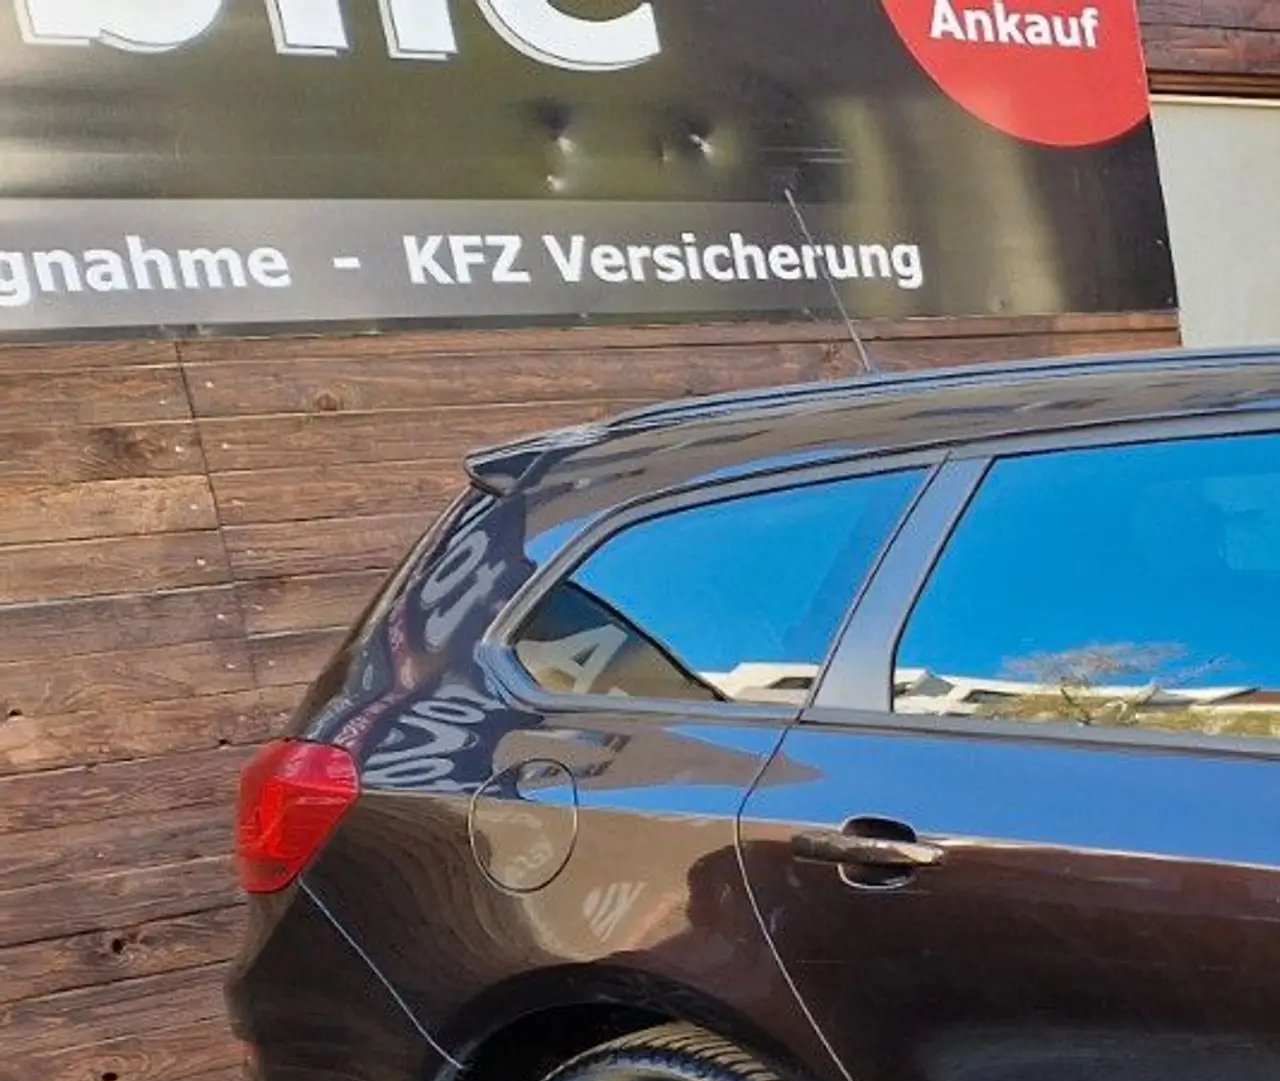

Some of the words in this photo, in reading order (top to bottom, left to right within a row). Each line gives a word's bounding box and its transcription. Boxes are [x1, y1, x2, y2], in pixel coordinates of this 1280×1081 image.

[930, 0, 1099, 48] Ankauf
[402, 235, 530, 284] KFZ
[543, 233, 923, 289] Versicherung
